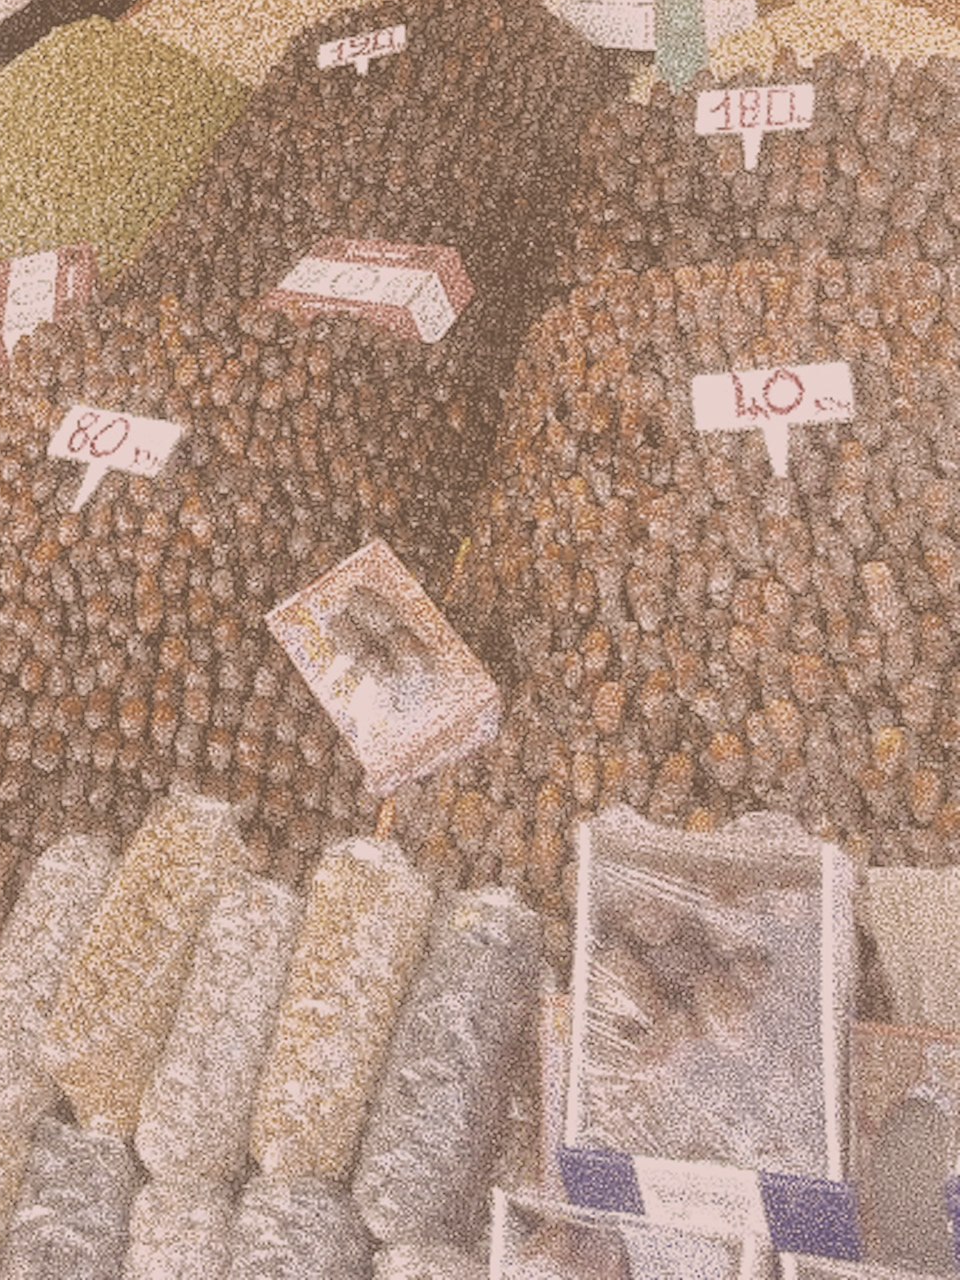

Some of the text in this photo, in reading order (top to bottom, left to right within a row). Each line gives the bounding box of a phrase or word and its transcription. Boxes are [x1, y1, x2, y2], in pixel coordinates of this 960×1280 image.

[708, 88, 796, 131] 180
[729, 368, 805, 419] 40
[67, 410, 132, 458] 80
